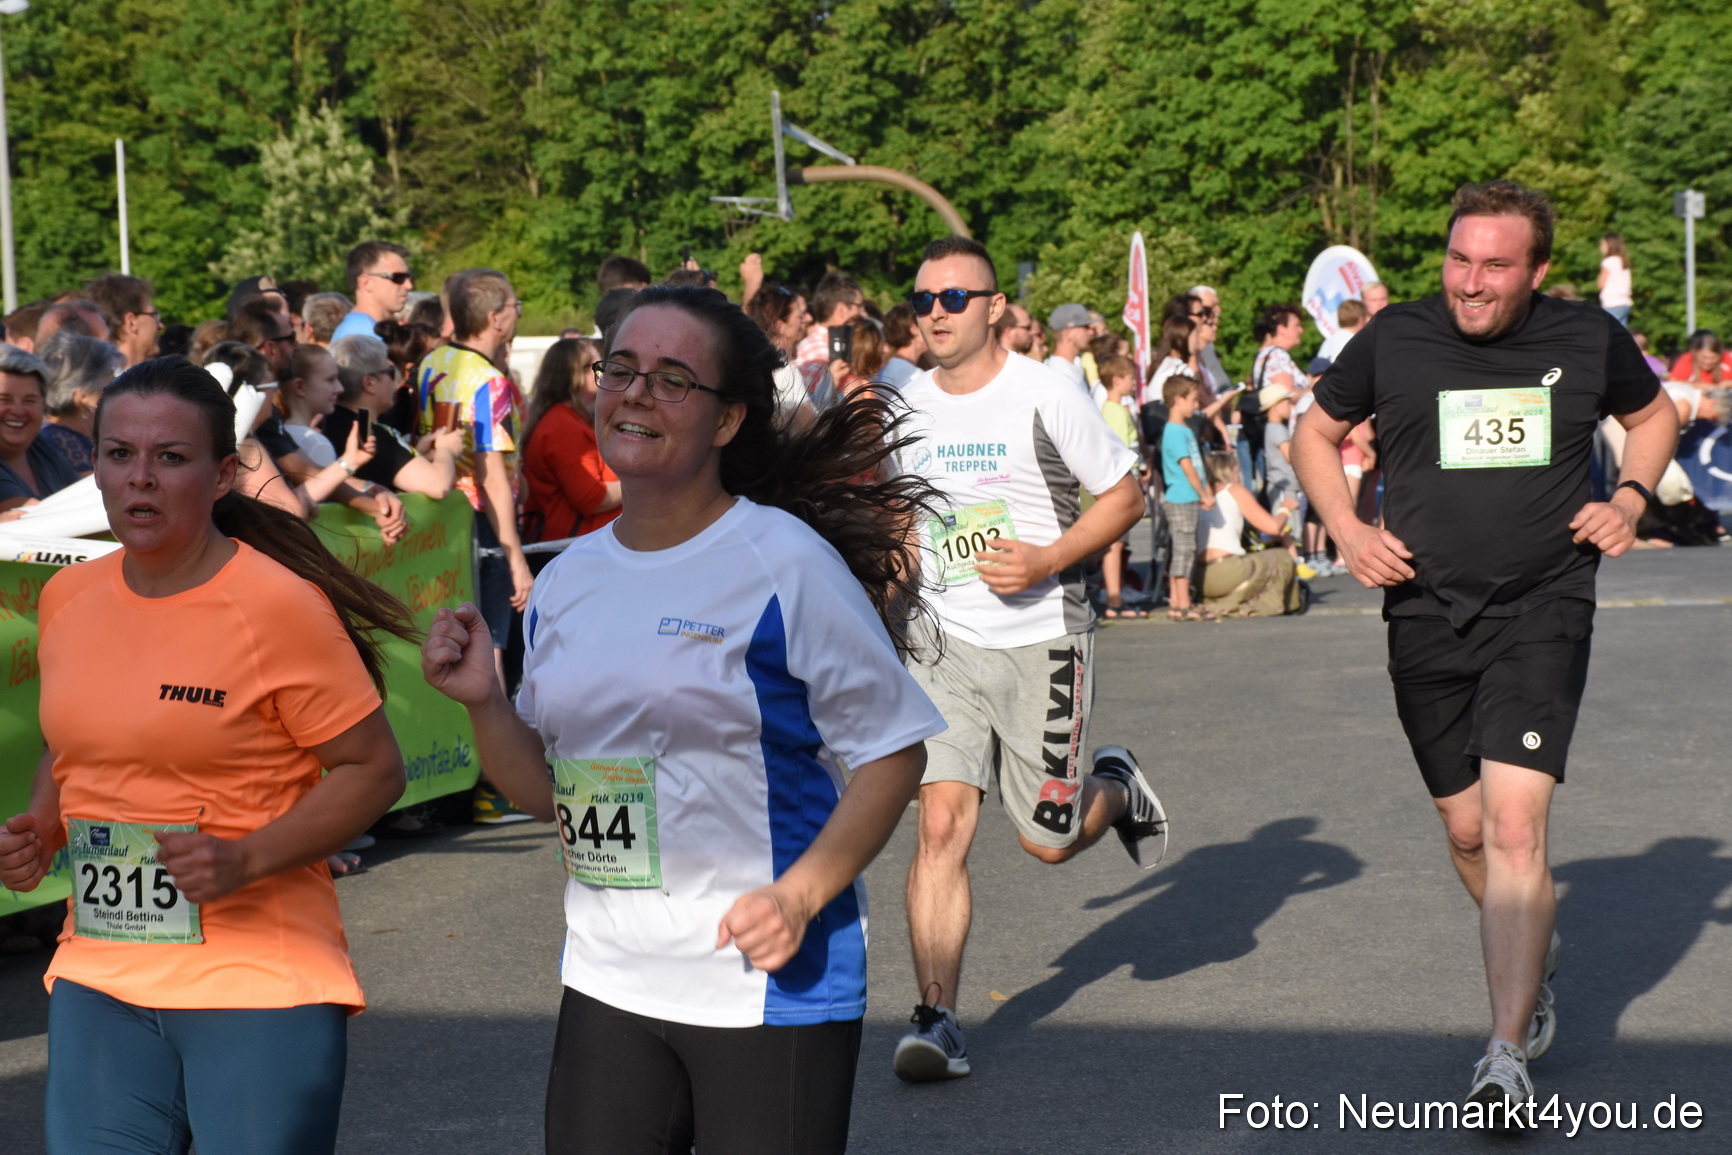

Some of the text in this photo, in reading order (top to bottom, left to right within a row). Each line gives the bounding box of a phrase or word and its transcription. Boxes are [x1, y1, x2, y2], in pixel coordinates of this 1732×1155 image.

[1464, 418, 1525, 445] 435
[937, 443, 1007, 458] HAUBNER
[1500, 446, 1526, 454] Stefan
[945, 460, 998, 472] TREPPEN
[683, 620, 724, 637] PETTER
[159, 684, 227, 707] THULE
[614, 792, 644, 803] 2019
[557, 803, 636, 849] 844
[588, 851, 617, 864] Dörte
[603, 865, 627, 874] GmbH
[82, 863, 178, 909] 2315
[93, 908, 164, 922] Steindl Bettina
[106, 921, 147, 931] Thule GmbH
